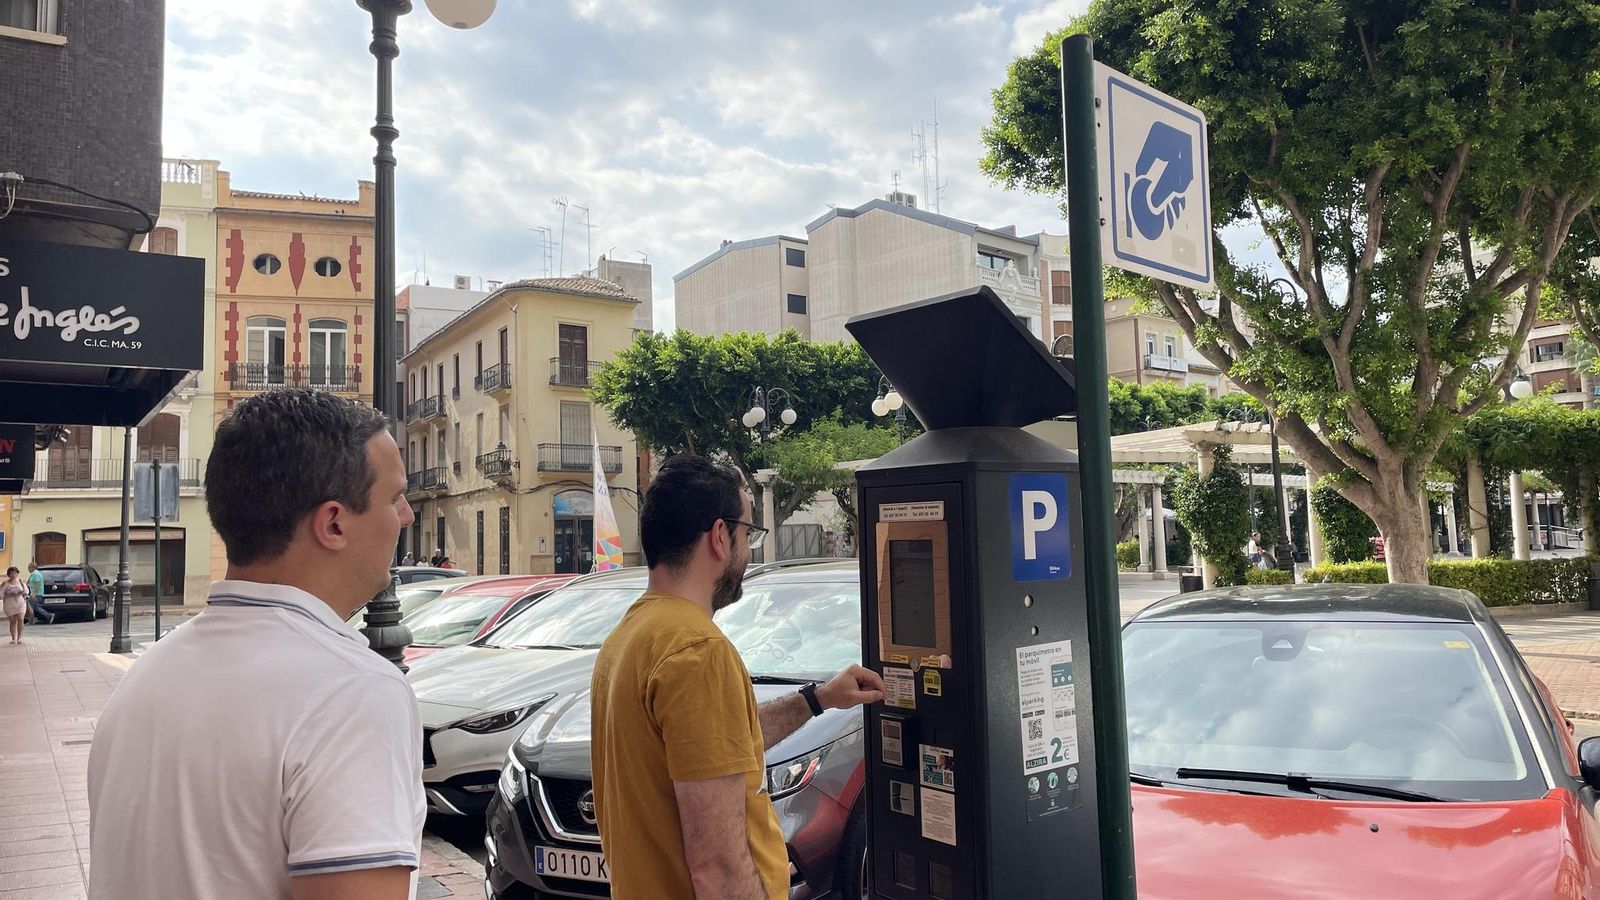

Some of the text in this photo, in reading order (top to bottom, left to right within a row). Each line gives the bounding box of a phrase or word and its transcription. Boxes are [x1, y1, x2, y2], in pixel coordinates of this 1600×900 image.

[13, 286, 140, 342] Inglés
[84, 338, 142, 349] C.I.C. MA. 59
[1022, 490, 1058, 560] P
[1026, 757, 1047, 768] ALZIRA
[1050, 737, 1063, 763] 2
[548, 851, 591, 876] 0110
